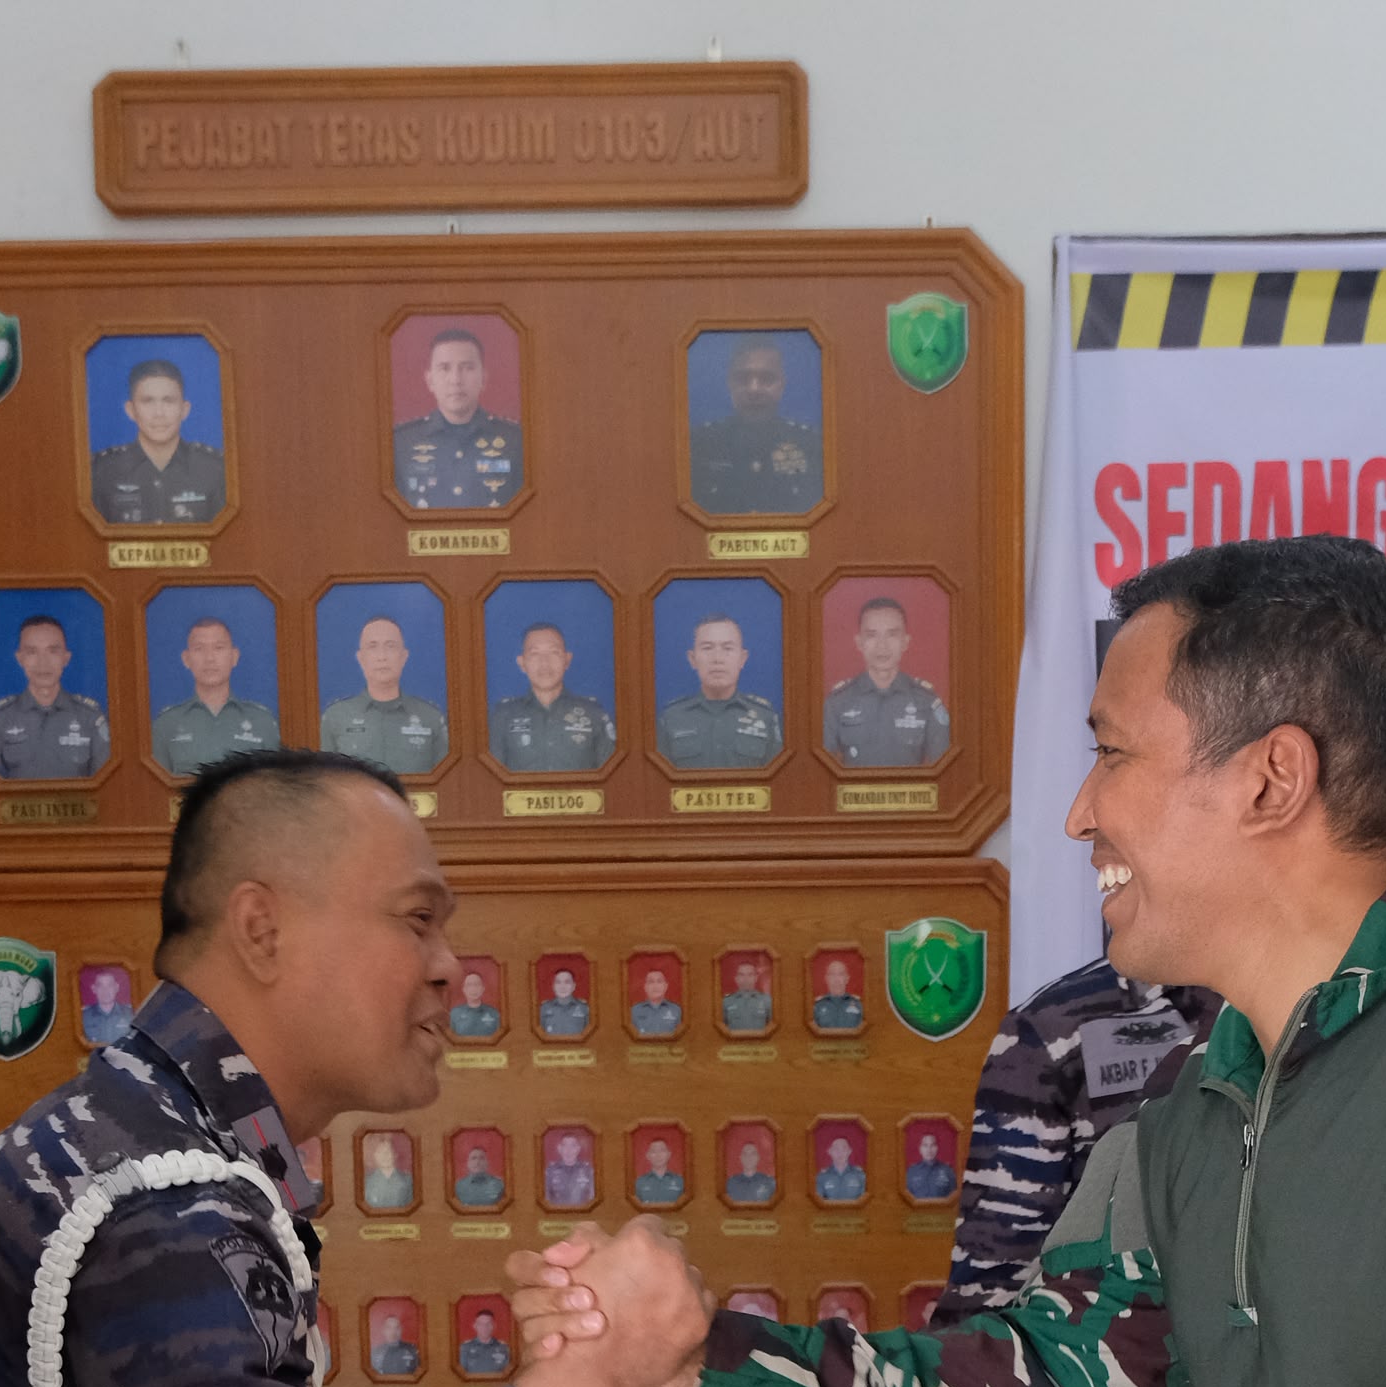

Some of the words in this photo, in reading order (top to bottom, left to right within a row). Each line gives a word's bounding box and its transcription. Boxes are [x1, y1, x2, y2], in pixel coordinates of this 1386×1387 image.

[134, 117, 294, 171] PEJABAT
[311, 113, 421, 168] TERAS
[435, 111, 556, 166] KODIM
[573, 109, 766, 165] 0103/AUT
[419, 535, 500, 550] KOMANDAN
[718, 538, 769, 553] PABUNG
[773, 537, 798, 552] AUT
[117, 547, 167, 562] KEPALA
[525, 796, 555, 810] PASI
[558, 795, 584, 809] LOG
[685, 792, 721, 807] PASI
[726, 791, 756, 806] TER
[1099, 1059, 1138, 1087] AKBAR
